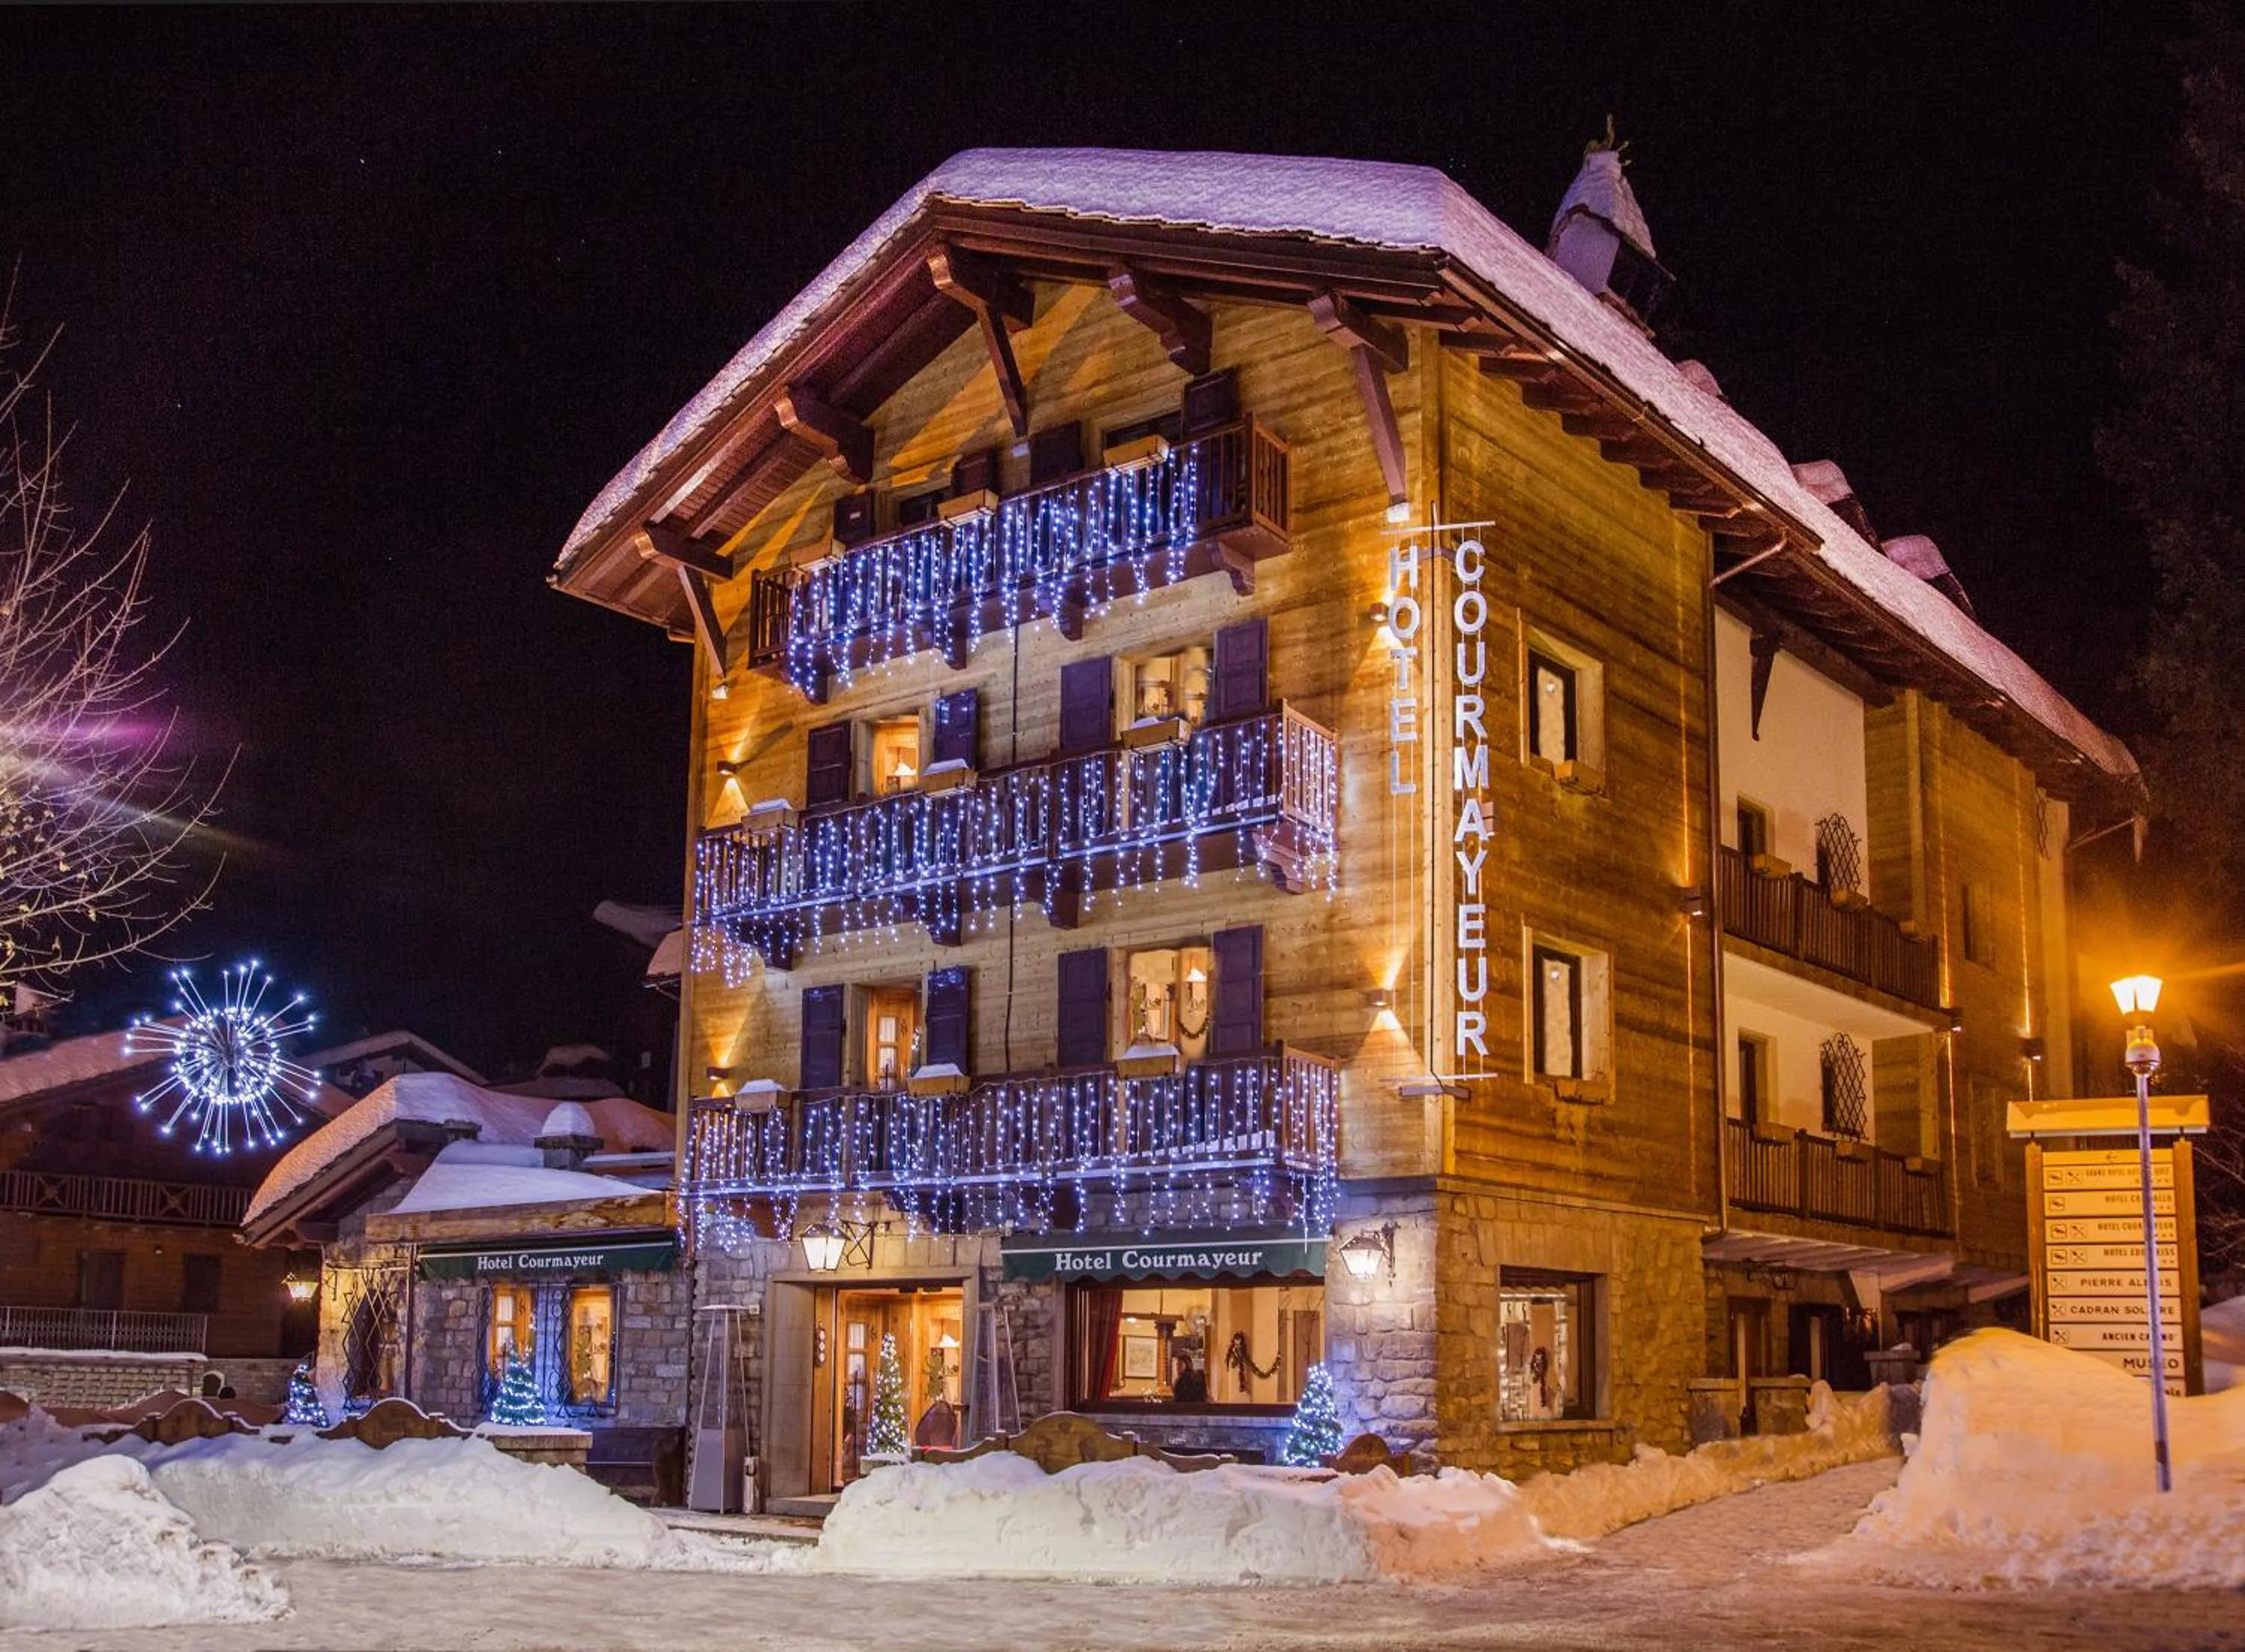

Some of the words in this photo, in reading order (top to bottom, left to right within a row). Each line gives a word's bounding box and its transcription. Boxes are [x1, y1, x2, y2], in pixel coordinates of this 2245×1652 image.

[1388, 545, 1420, 795] HOTEL
[1453, 539, 1490, 1056] COURMAYEUR
[2106, 1195, 2128, 1203] HOTEL
[2098, 1223, 2120, 1231] HOTEL
[2104, 1249, 2128, 1257] HOTEL
[477, 1256, 513, 1270] Hotel
[519, 1254, 604, 1268] Courmayeur
[1054, 1252, 1111, 1270] Hotel
[1122, 1249, 1262, 1270] Courmayeur
[2080, 1279, 2122, 1287] PIERRE
[2071, 1306, 2119, 1315] CADRAN
[2125, 1306, 2175, 1315] SOLRE
[2102, 1333, 2136, 1341] ANCIEN
